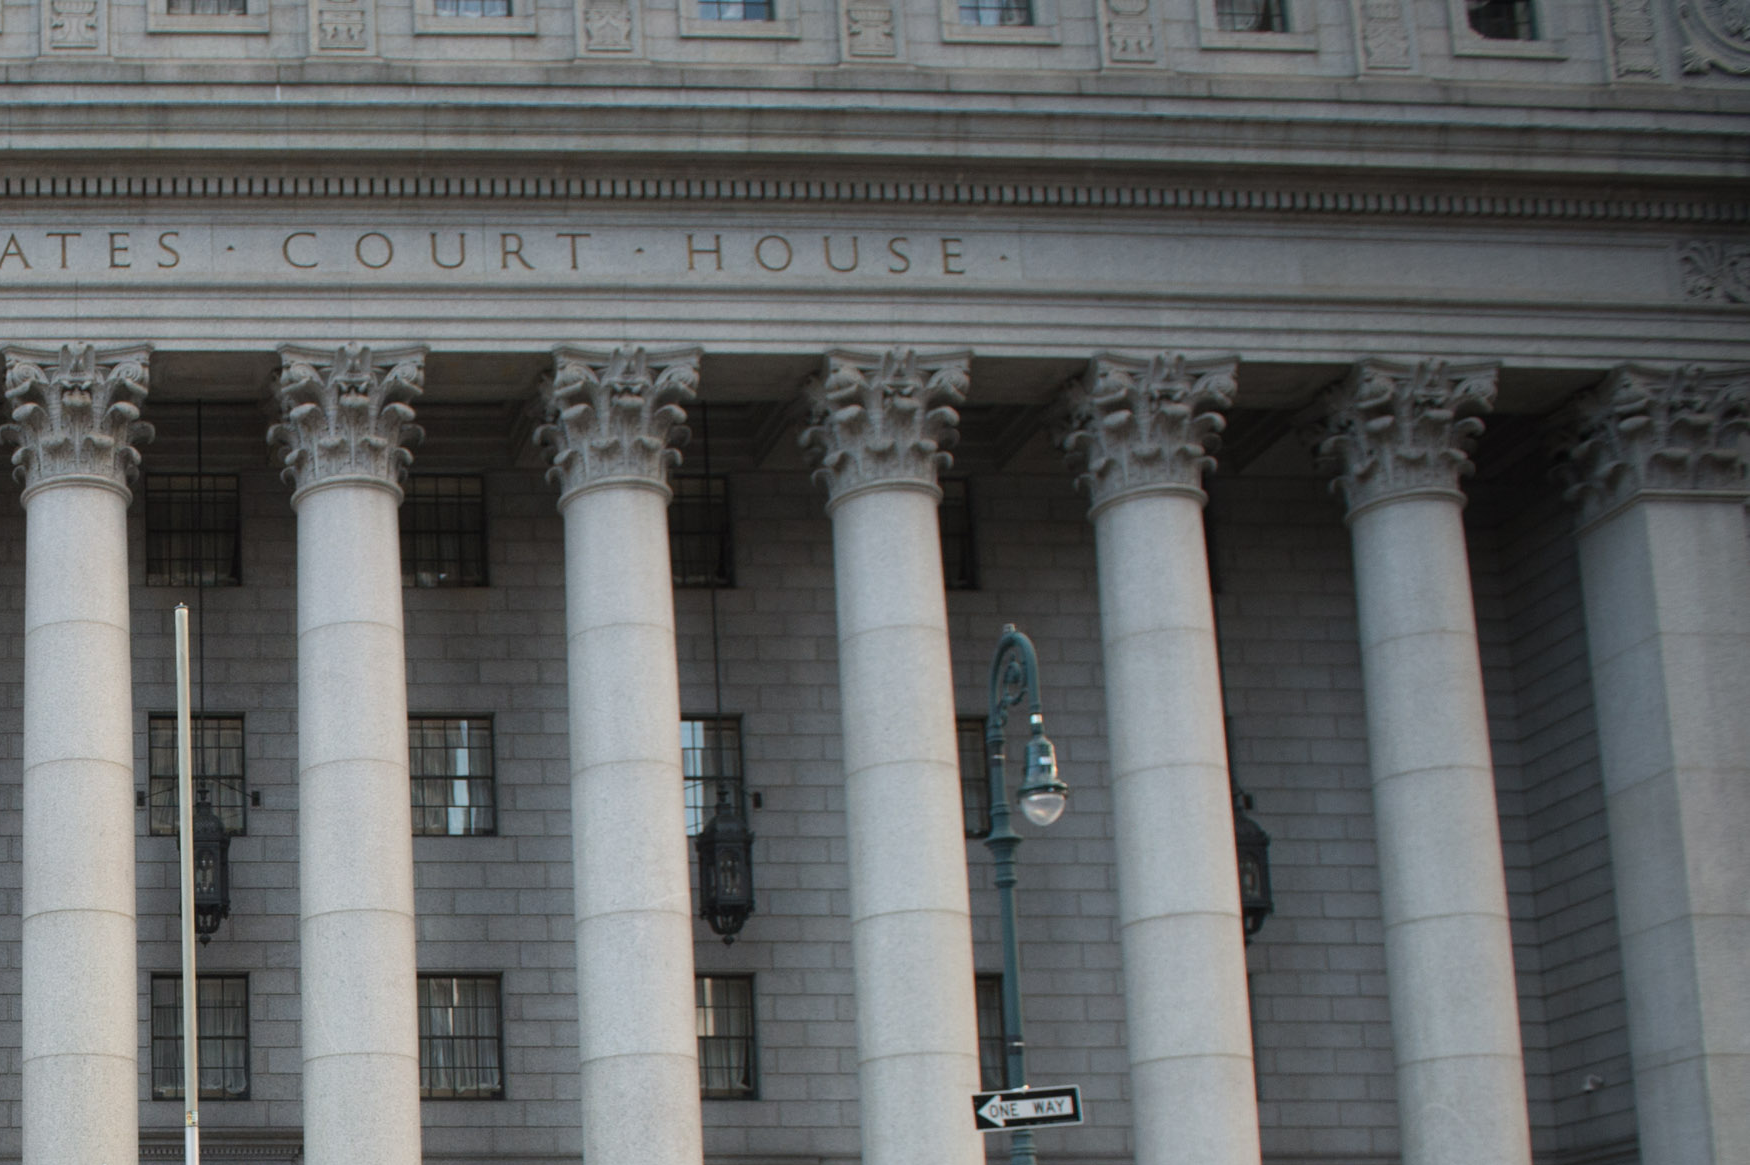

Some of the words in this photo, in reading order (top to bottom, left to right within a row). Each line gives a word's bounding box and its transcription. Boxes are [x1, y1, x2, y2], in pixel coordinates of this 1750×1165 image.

[281, 231, 592, 272] COURT
[685, 233, 967, 276] HOUSE
[989, 1102, 1019, 1118] ONE
[1032, 1099, 1065, 1115] WAY
